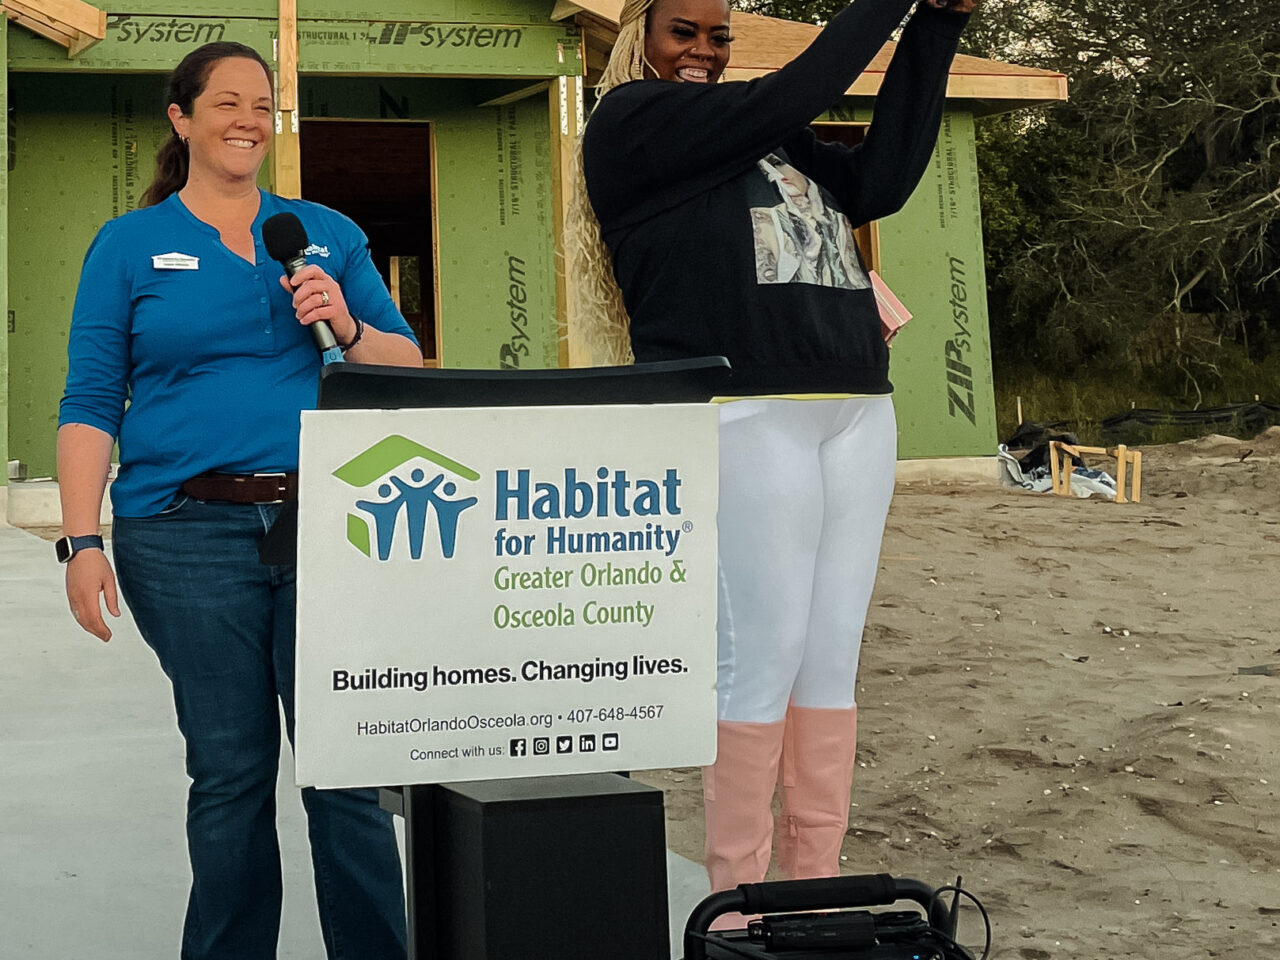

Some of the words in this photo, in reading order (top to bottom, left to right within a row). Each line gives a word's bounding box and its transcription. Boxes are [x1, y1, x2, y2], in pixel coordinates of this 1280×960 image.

[509, 141, 518, 190] STRUCTURAL
[500, 255, 531, 369] Psystem
[495, 466, 682, 521] Habitat
[494, 528, 536, 557] for
[493, 565, 574, 591] Greater
[580, 561, 662, 588] Orlando
[669, 560, 687, 583] &
[493, 603, 575, 629] Osceola
[582, 600, 655, 627] County
[332, 667, 428, 692] Building
[432, 664, 517, 687] homes.
[520, 657, 629, 682] Changing
[632, 655, 689, 677] lives.
[357, 713, 553, 736] HabitatOrlandoOsceola.org
[566, 705, 664, 725] 407-648-4567
[409, 747, 459, 761] Connect
[462, 745, 486, 759] with
[488, 745, 505, 757] us:
